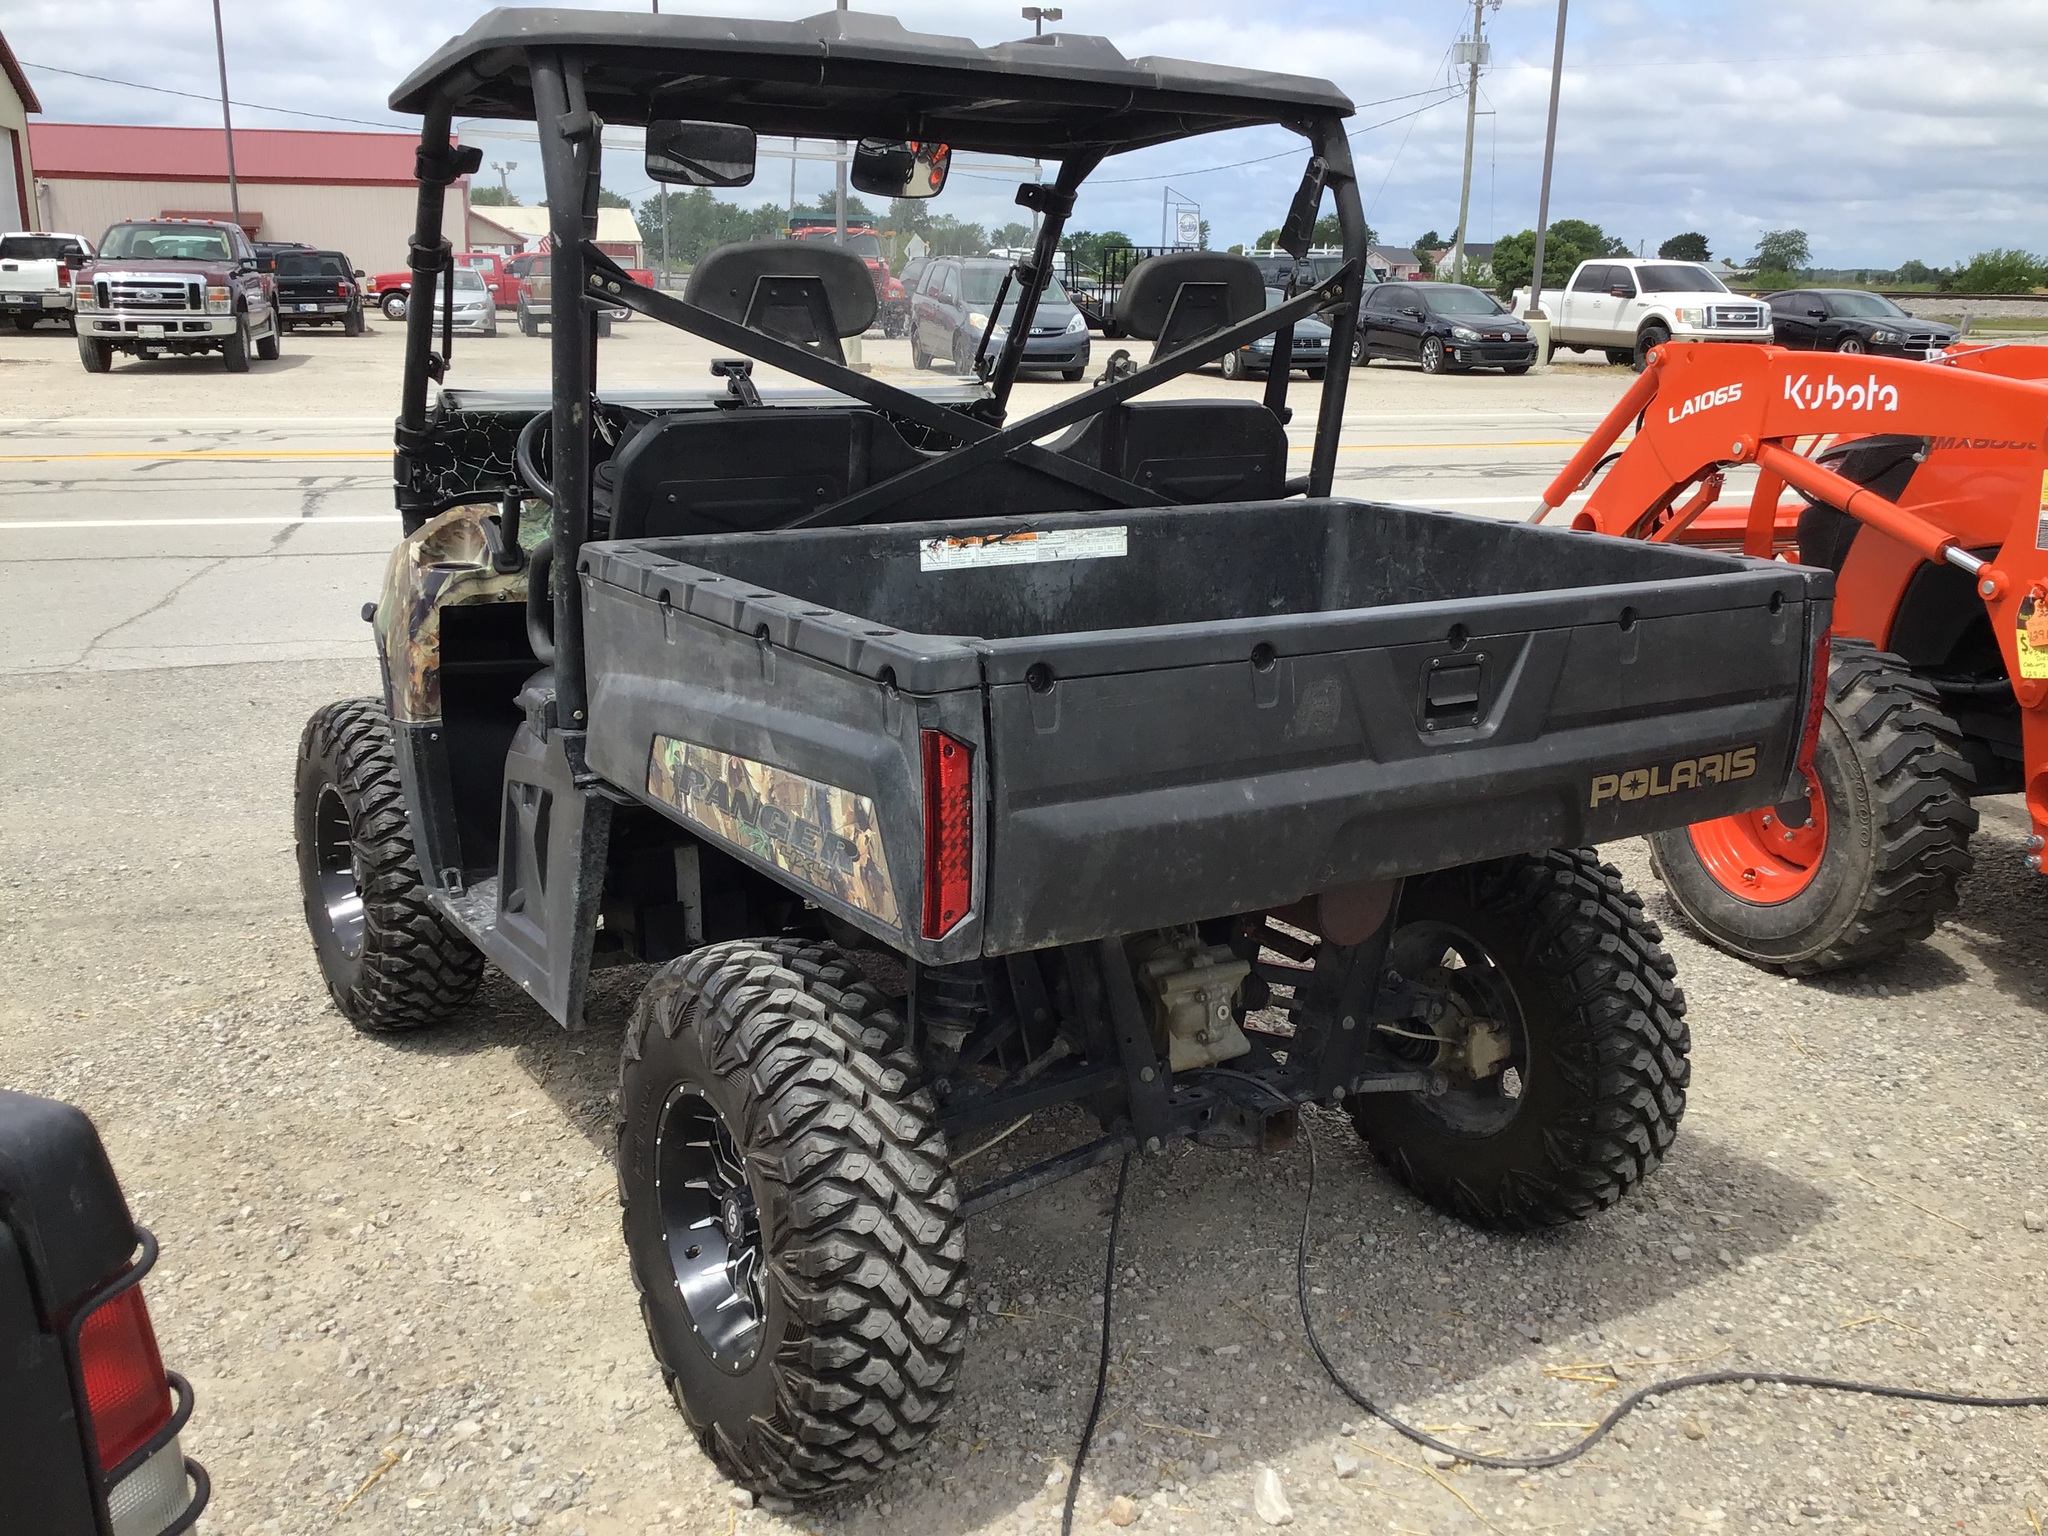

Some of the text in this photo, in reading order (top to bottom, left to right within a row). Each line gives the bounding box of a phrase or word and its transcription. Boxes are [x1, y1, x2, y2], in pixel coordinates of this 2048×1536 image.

[1668, 382, 1743, 424] LA1065
[1784, 374, 1898, 411] Kubota
[1590, 746, 1757, 808] POLARIS
[678, 764, 861, 876] RANGER
